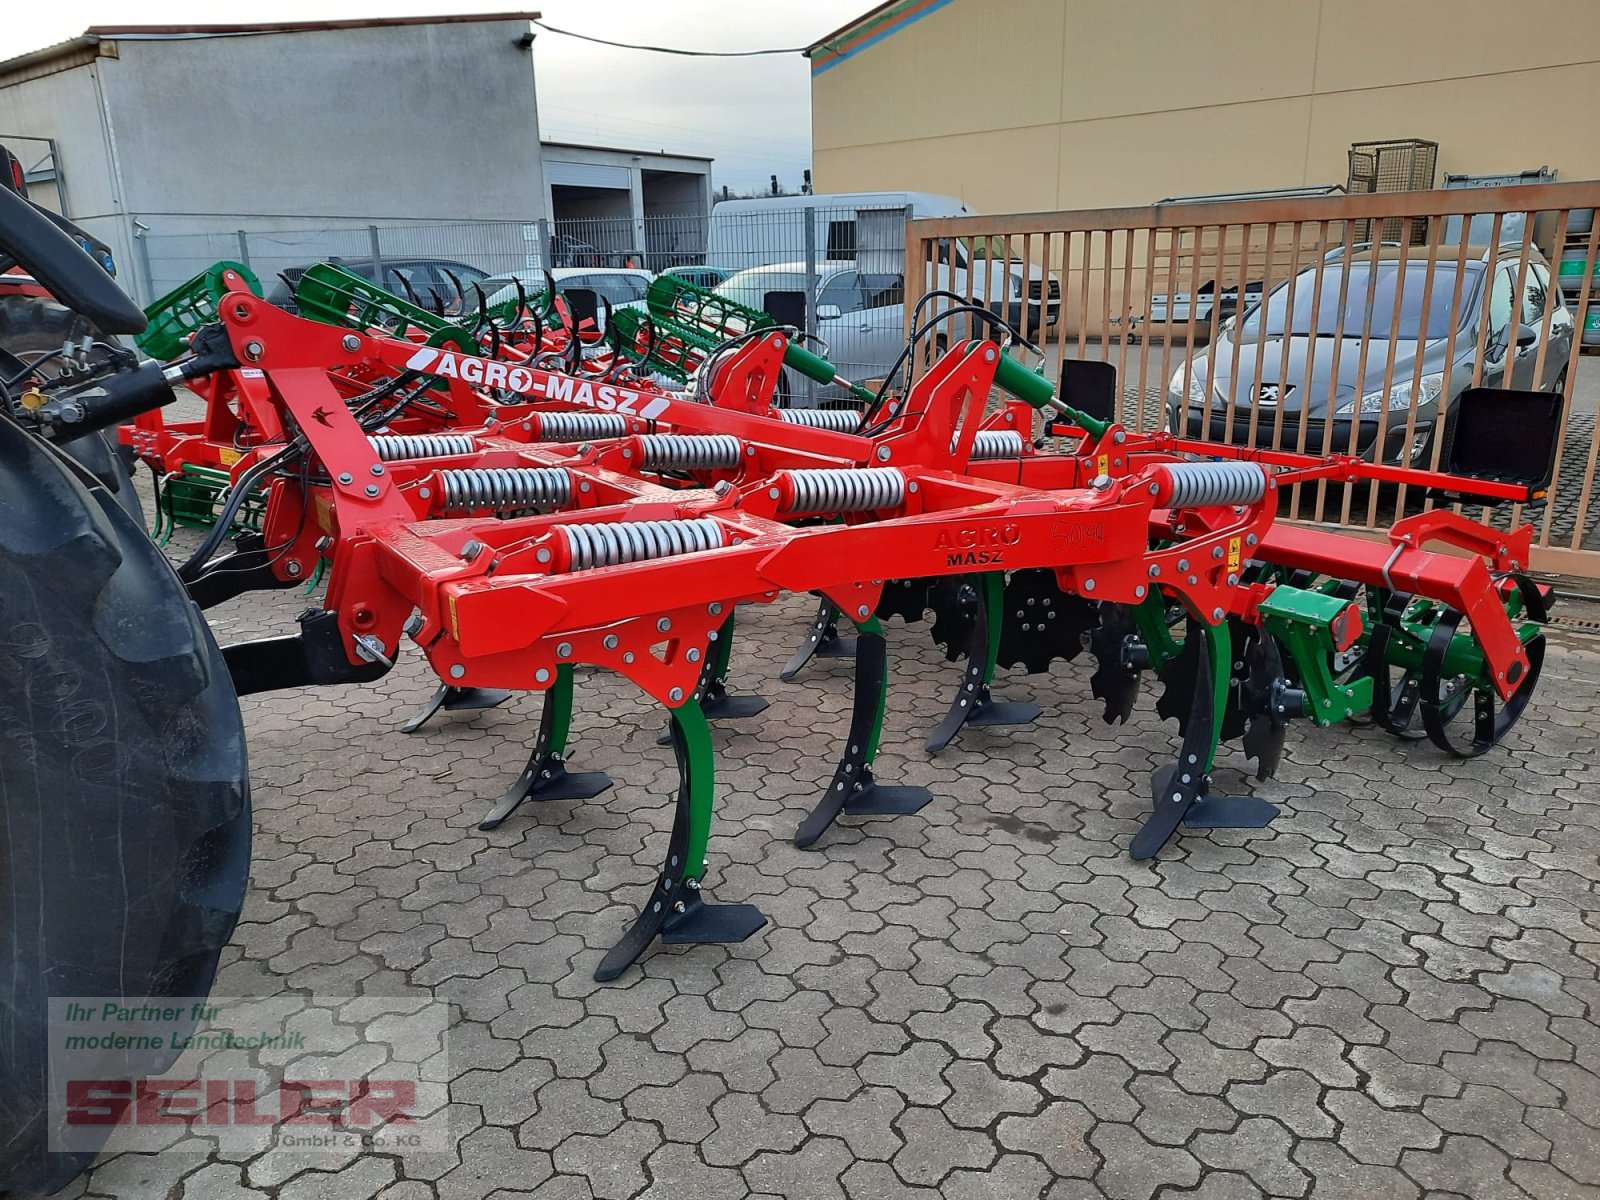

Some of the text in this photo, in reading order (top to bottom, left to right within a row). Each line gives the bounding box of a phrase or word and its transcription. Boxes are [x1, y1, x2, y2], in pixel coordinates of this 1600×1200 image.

[437, 352, 639, 415] AGRO-MASZ
[933, 523, 1021, 552] AGRO
[946, 550, 1005, 567] MASZ
